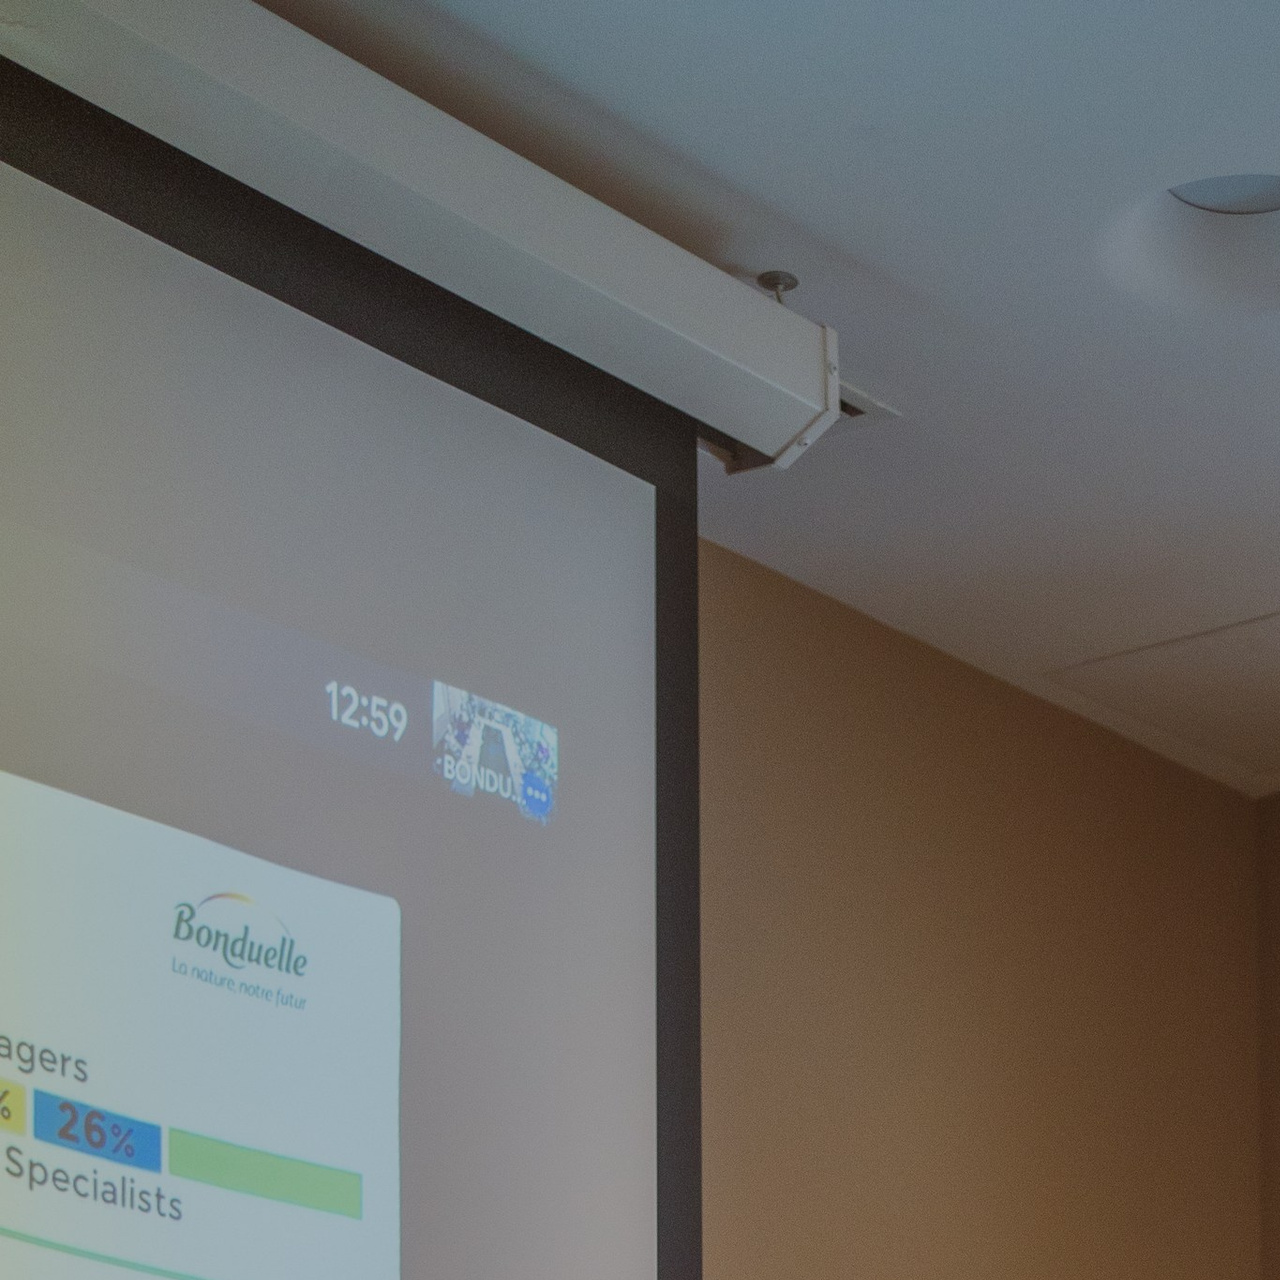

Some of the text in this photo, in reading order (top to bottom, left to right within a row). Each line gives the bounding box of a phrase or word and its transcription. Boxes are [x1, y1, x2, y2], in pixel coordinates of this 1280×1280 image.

[326, 681, 408, 742] 12:59
[173, 902, 307, 977] Bonduelle
[171, 956, 188, 976] La
[239, 980, 273, 1002] notre
[275, 988, 307, 1010] futur
[0, 1035, 88, 1083] agers
[57, 1102, 135, 1158] 26%
[5, 1146, 183, 1221] Specialists
